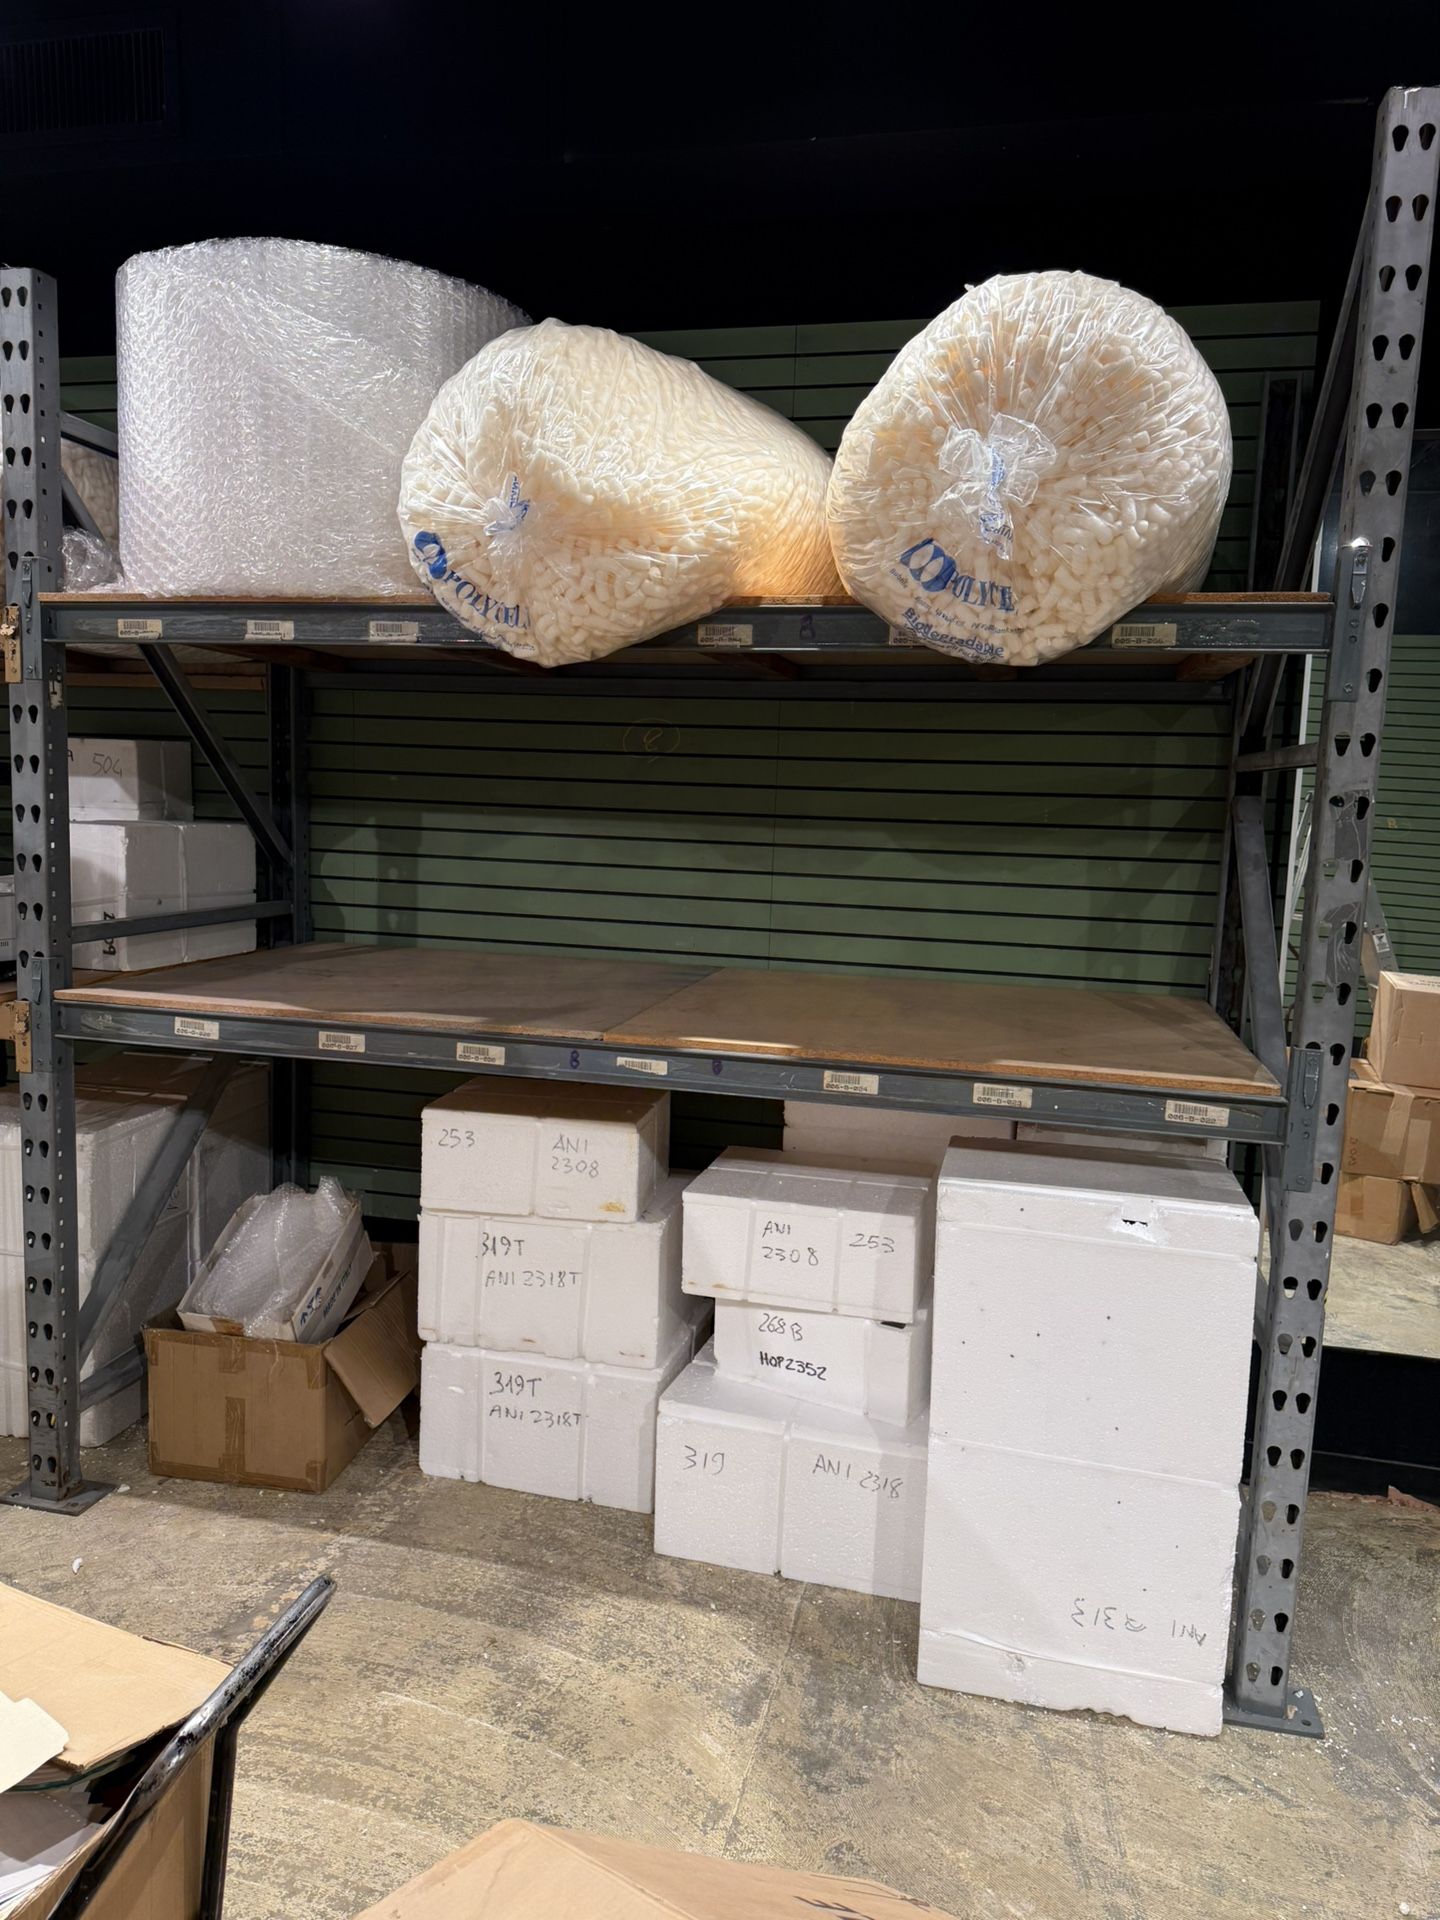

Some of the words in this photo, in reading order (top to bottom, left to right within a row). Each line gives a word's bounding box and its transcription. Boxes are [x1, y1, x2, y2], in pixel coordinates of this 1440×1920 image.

[92, 752, 123, 778] 504
[438, 1128, 476, 1149] 253
[551, 1156, 600, 1179] 2308
[480, 1231, 526, 1257] 319T
[761, 1246, 820, 1267] 2308
[848, 1233, 896, 1254] 253
[488, 1371, 542, 1398] 319T
[682, 1444, 726, 1476] 319
[858, 1470, 905, 1499] 2318
